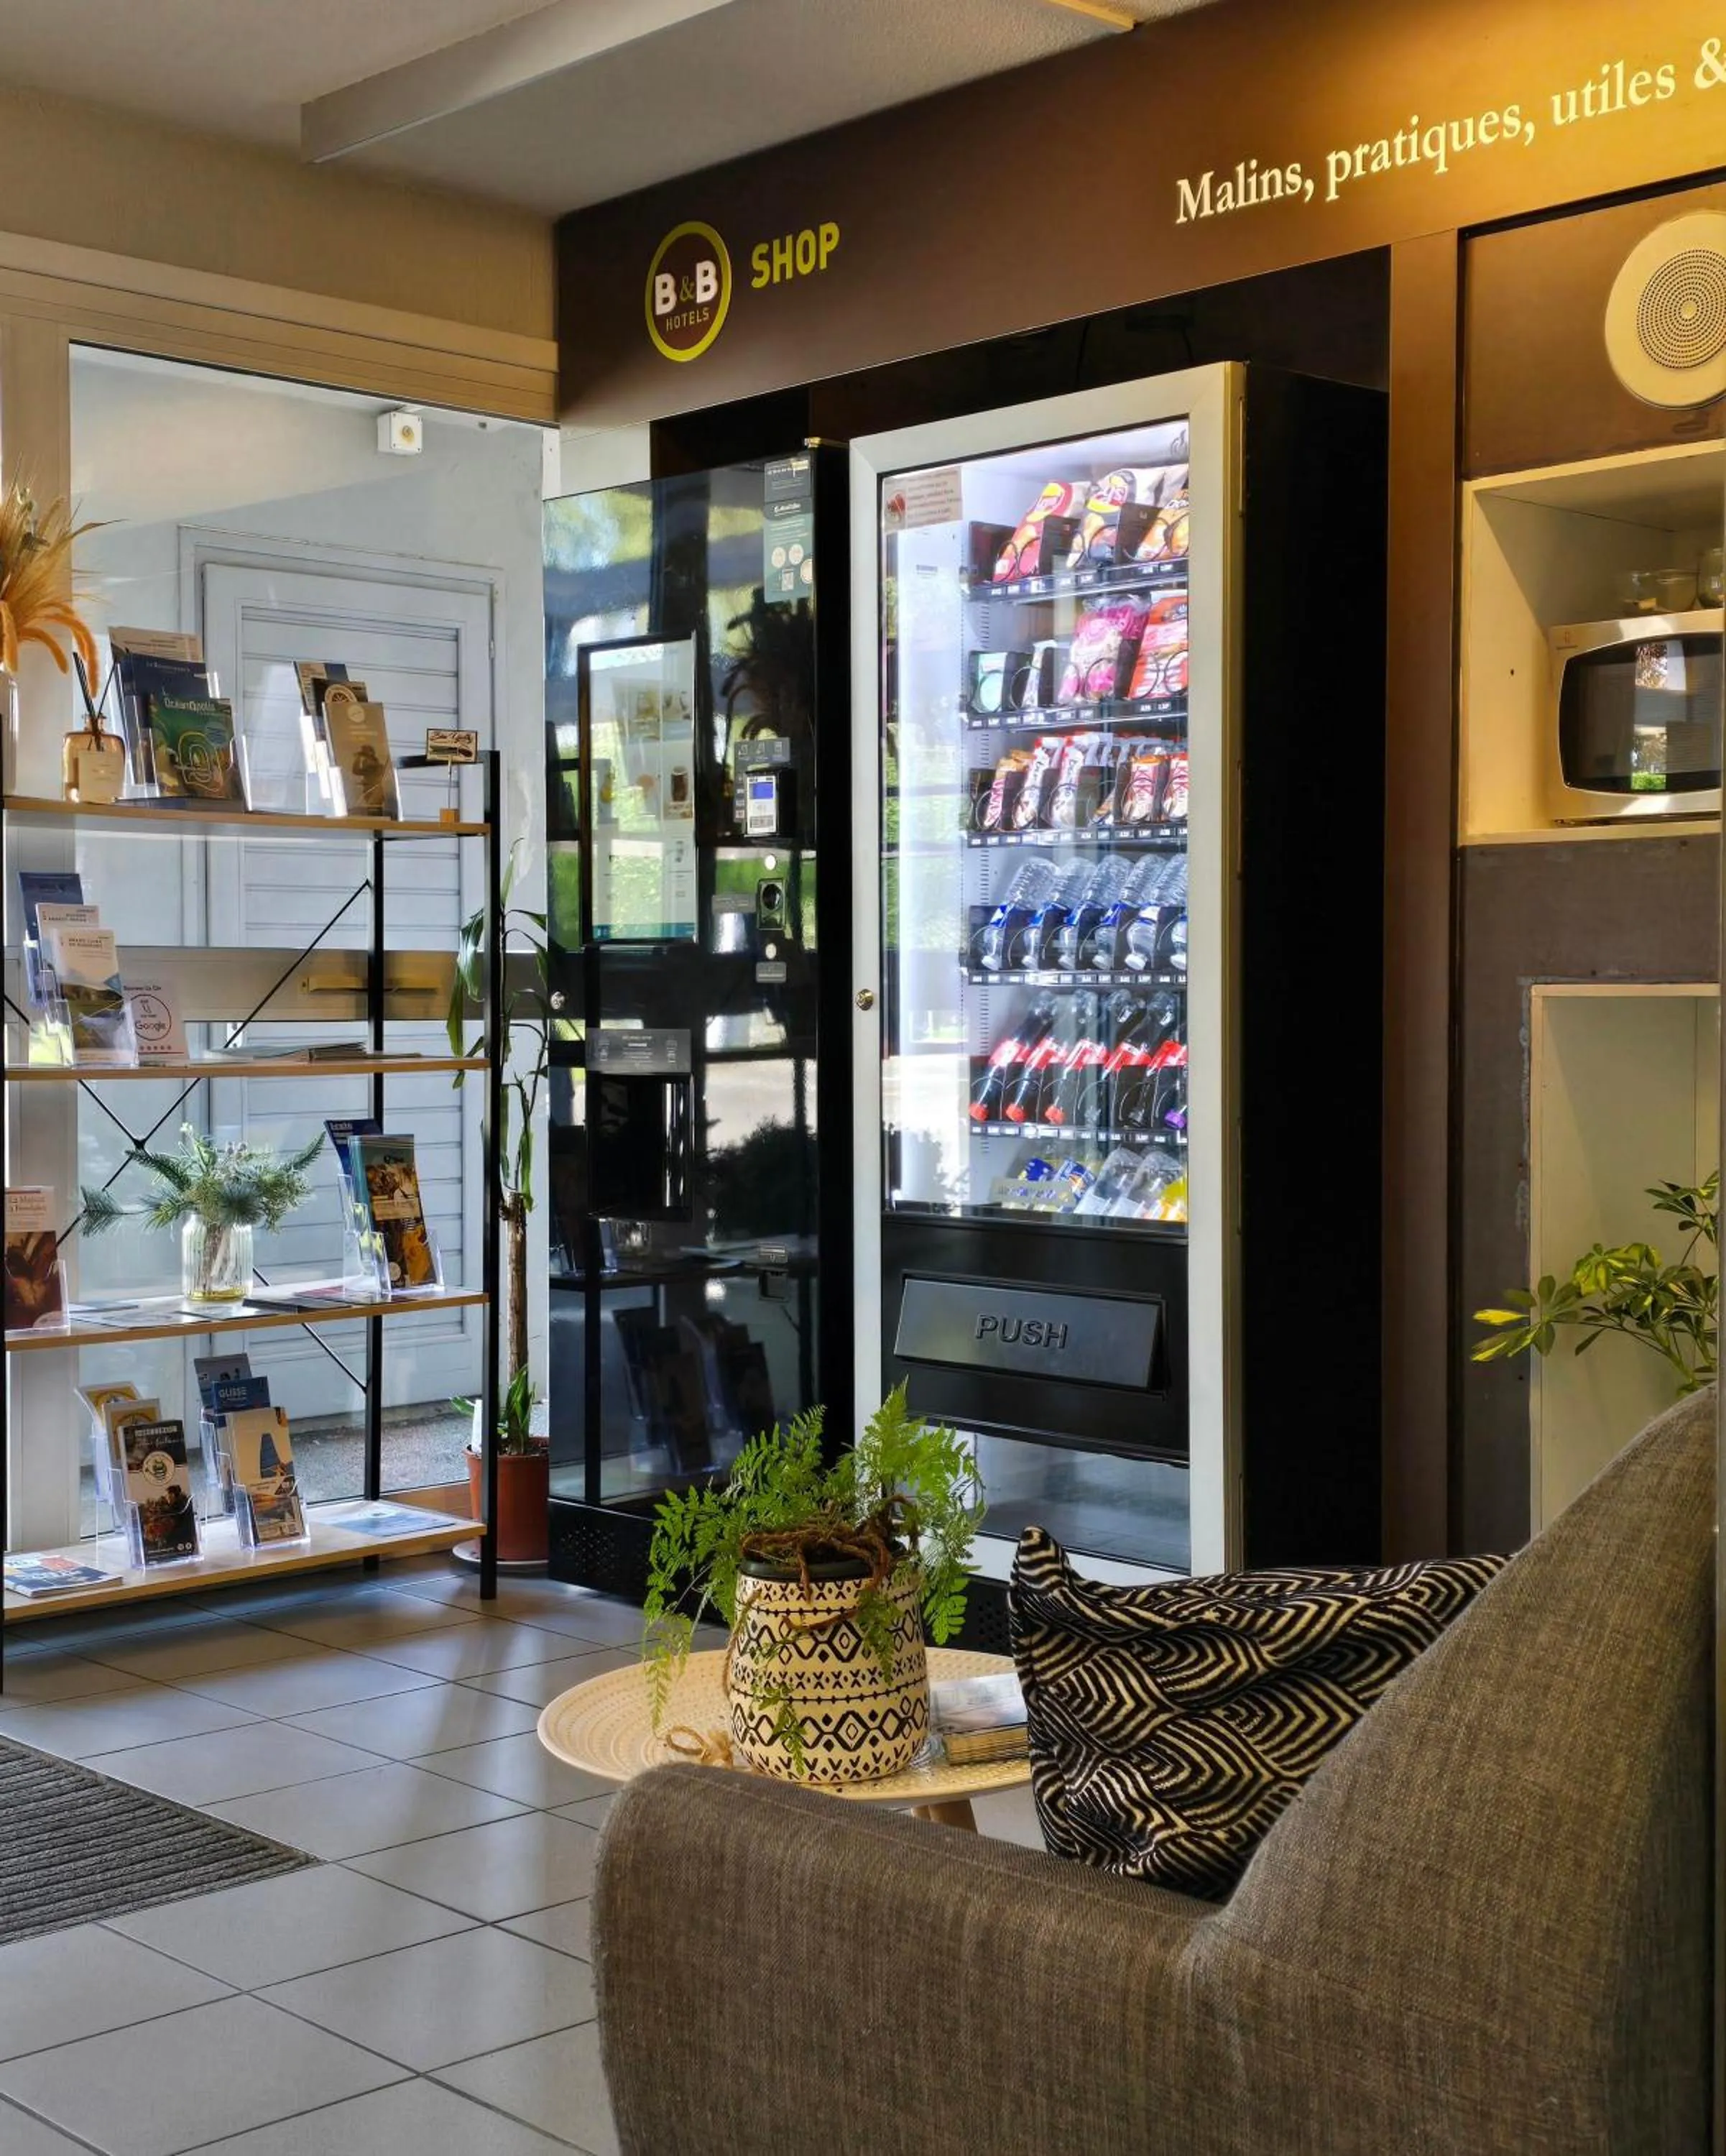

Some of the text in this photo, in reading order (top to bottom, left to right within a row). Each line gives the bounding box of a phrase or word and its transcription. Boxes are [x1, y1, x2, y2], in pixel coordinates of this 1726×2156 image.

[1176, 37, 1726, 224] Malins, pratiques, utiles &
[751, 221, 840, 288] SHOP
[655, 260, 719, 315] B&B
[665, 307, 710, 331] HOTELS
[135, 1021, 166, 1033] Google
[976, 1313, 1069, 1349] PUSH
